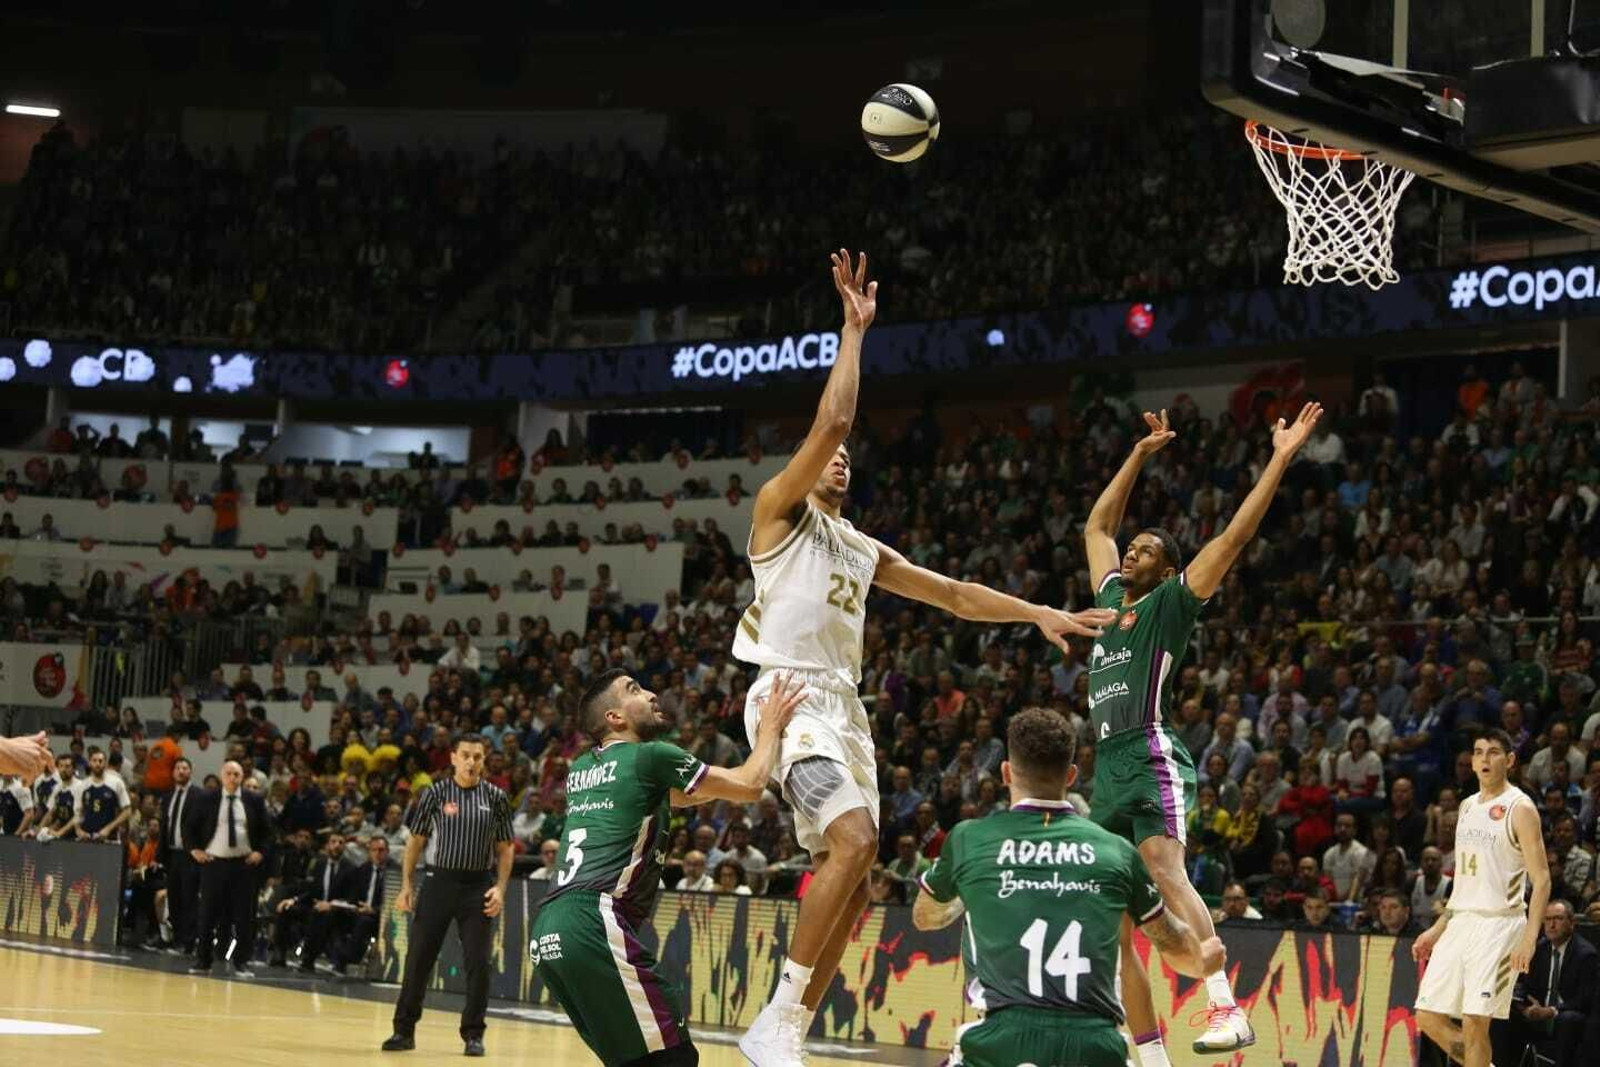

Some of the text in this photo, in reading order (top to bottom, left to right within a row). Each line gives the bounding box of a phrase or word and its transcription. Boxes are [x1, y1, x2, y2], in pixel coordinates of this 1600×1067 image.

[1449, 265, 1600, 310] #Copa
[671, 332, 839, 381] #CopaACB
[827, 572, 859, 615] 22
[557, 827, 588, 887] 3
[996, 838, 1096, 865] ADAMS
[1461, 851, 1477, 877] 14
[1019, 917, 1092, 1003] 14
